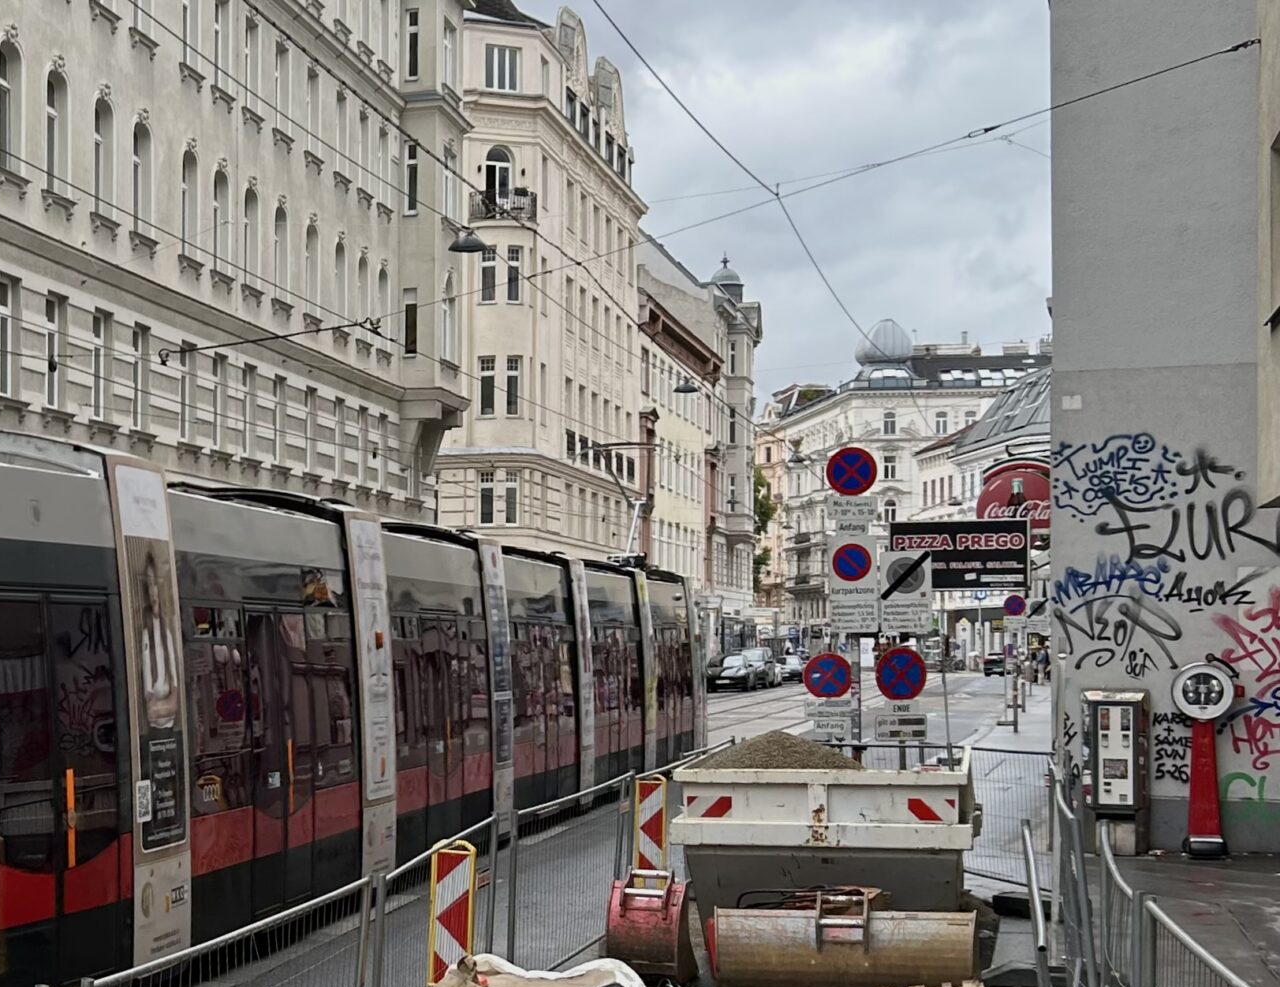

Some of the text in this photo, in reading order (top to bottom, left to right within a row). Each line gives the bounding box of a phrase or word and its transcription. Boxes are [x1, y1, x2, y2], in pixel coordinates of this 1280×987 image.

[893, 532, 1025, 550] PIZZA PREGO
[1154, 748, 1186, 762] SUN
